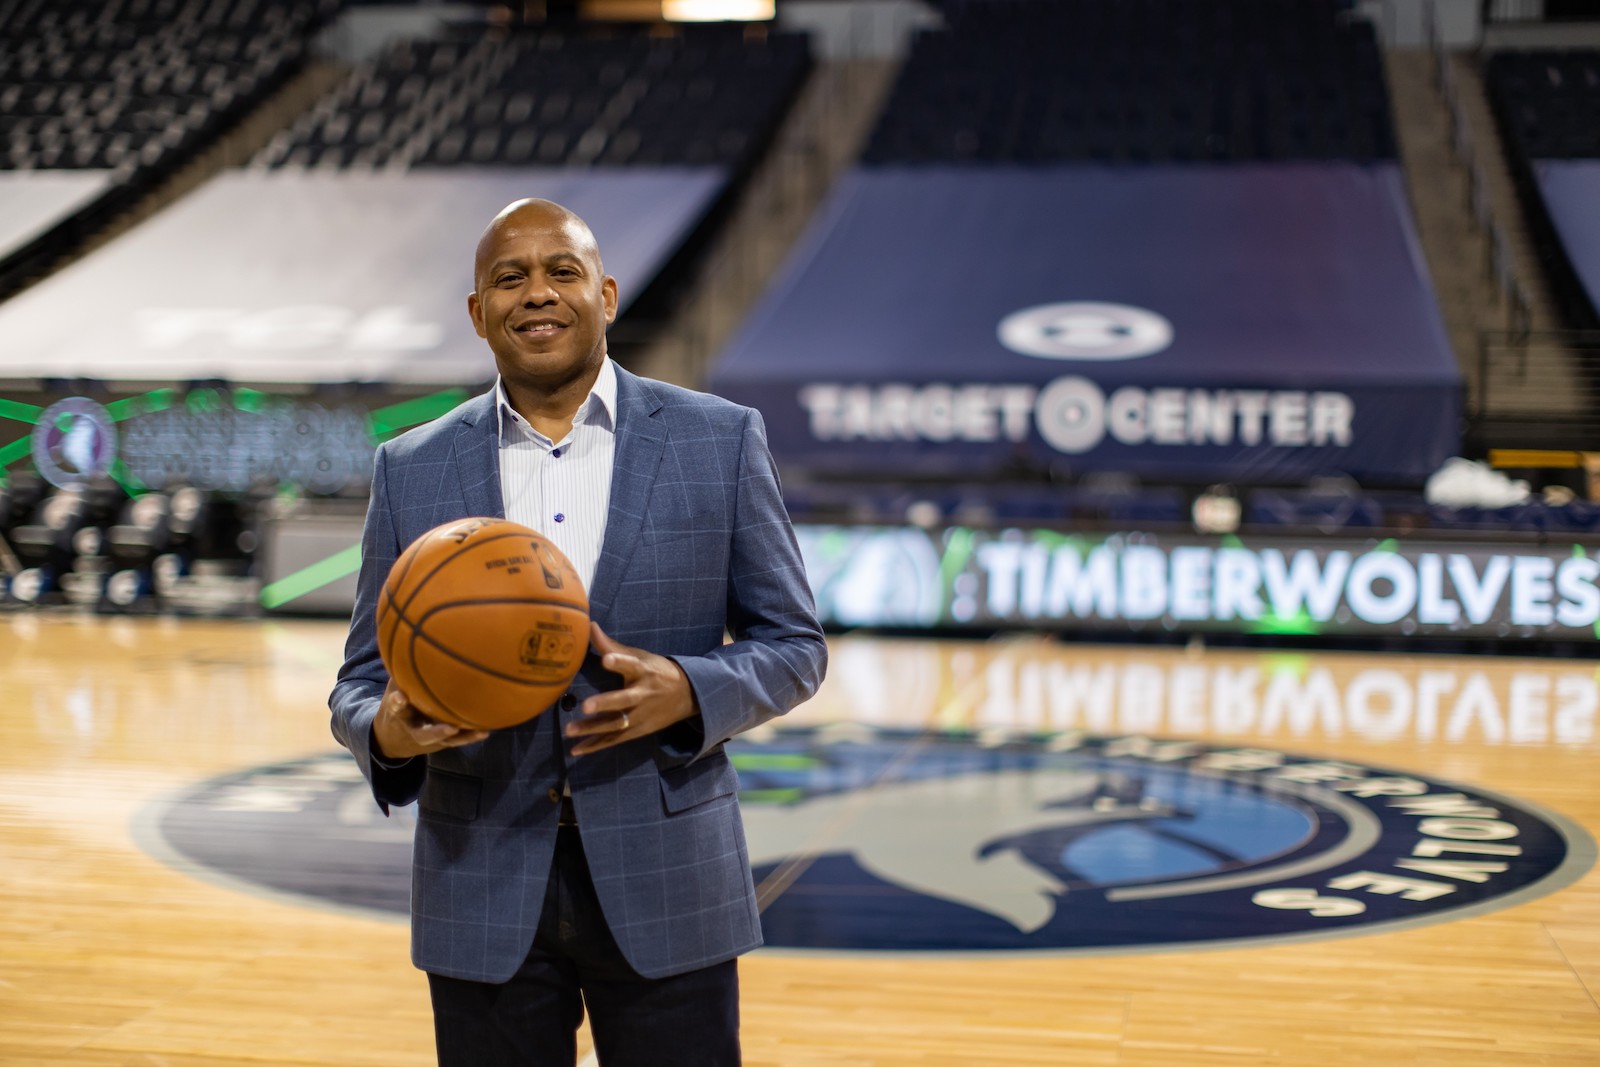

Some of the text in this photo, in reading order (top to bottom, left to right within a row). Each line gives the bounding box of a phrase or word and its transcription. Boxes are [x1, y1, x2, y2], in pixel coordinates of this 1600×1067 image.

[800, 384, 1354, 447] TARGET CENTER
[977, 541, 1600, 627] TIMBERWOLVES
